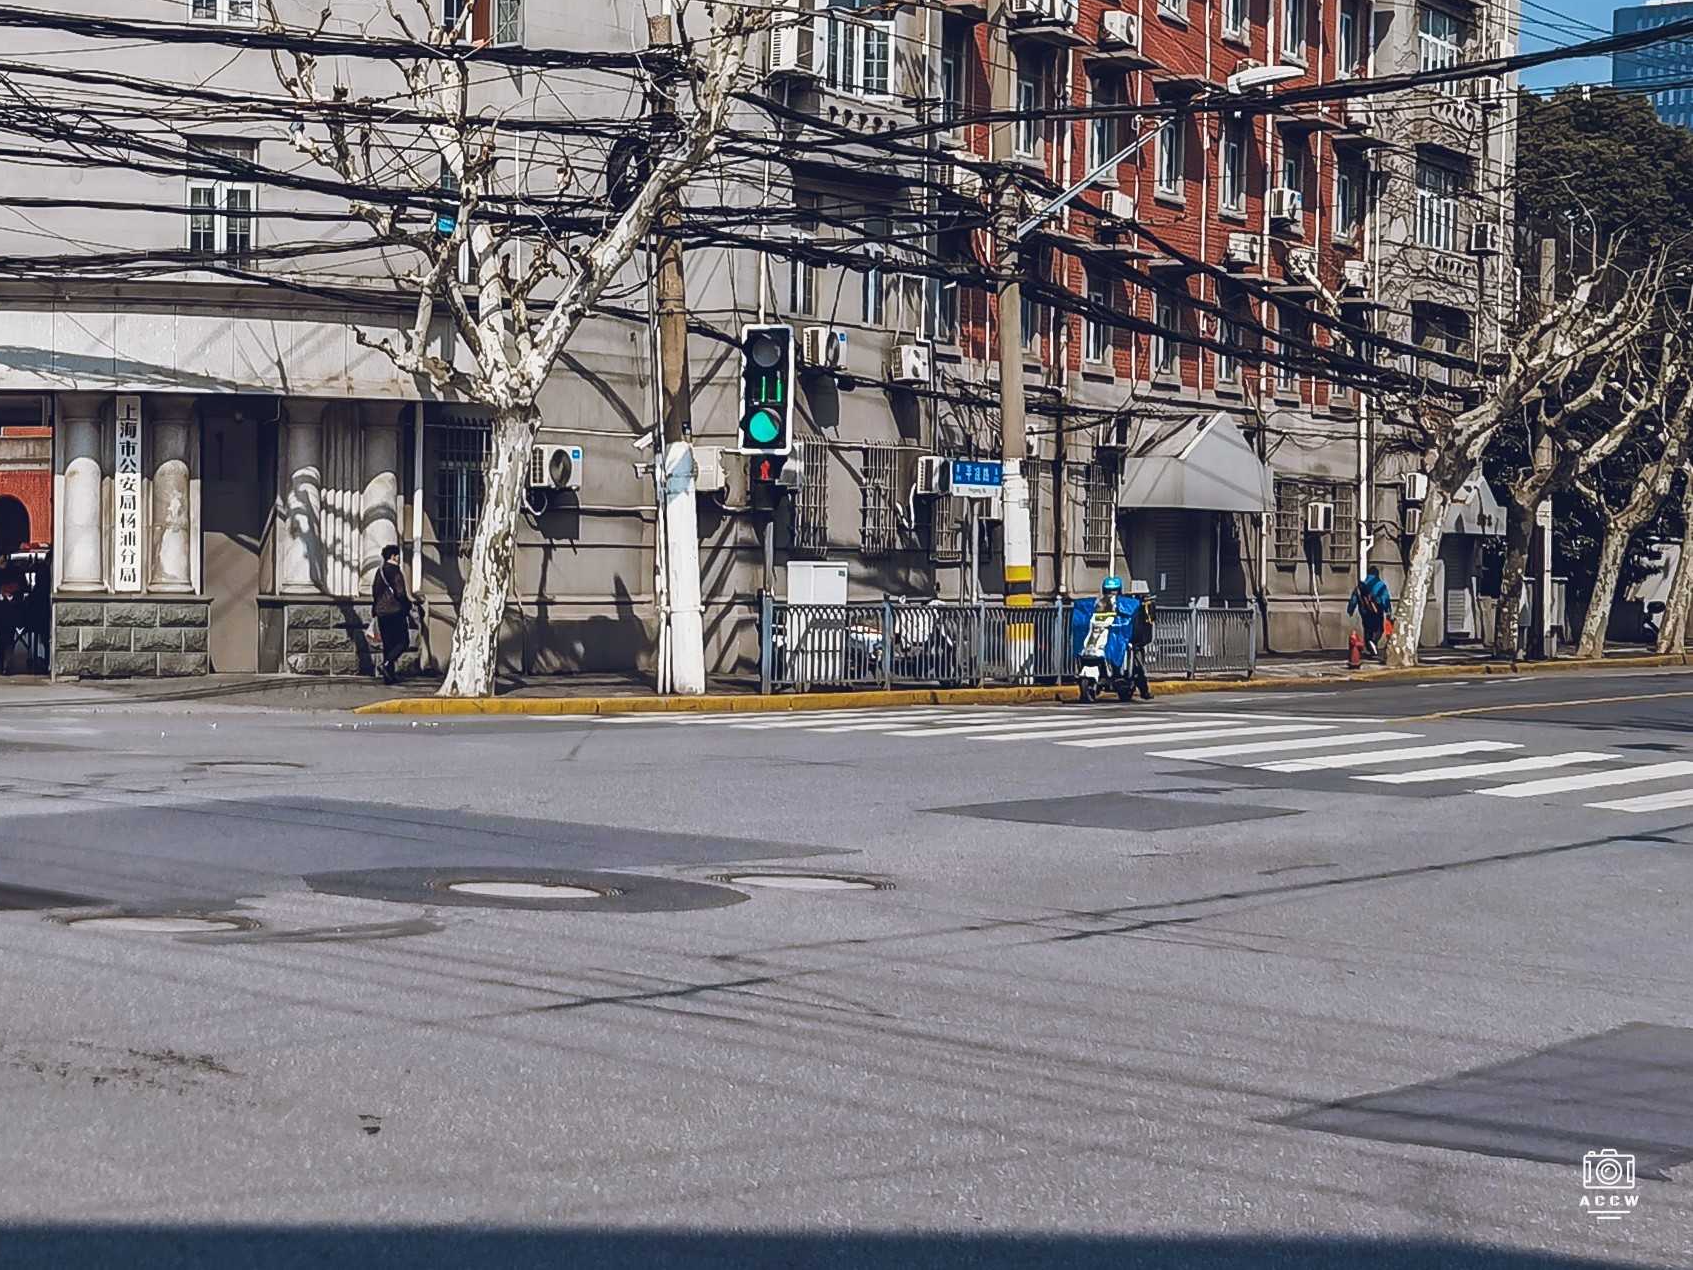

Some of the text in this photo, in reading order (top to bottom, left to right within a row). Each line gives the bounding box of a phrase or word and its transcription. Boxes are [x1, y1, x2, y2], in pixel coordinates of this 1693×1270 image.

[118, 403, 138, 583] 上海市公安局杨浦分局
